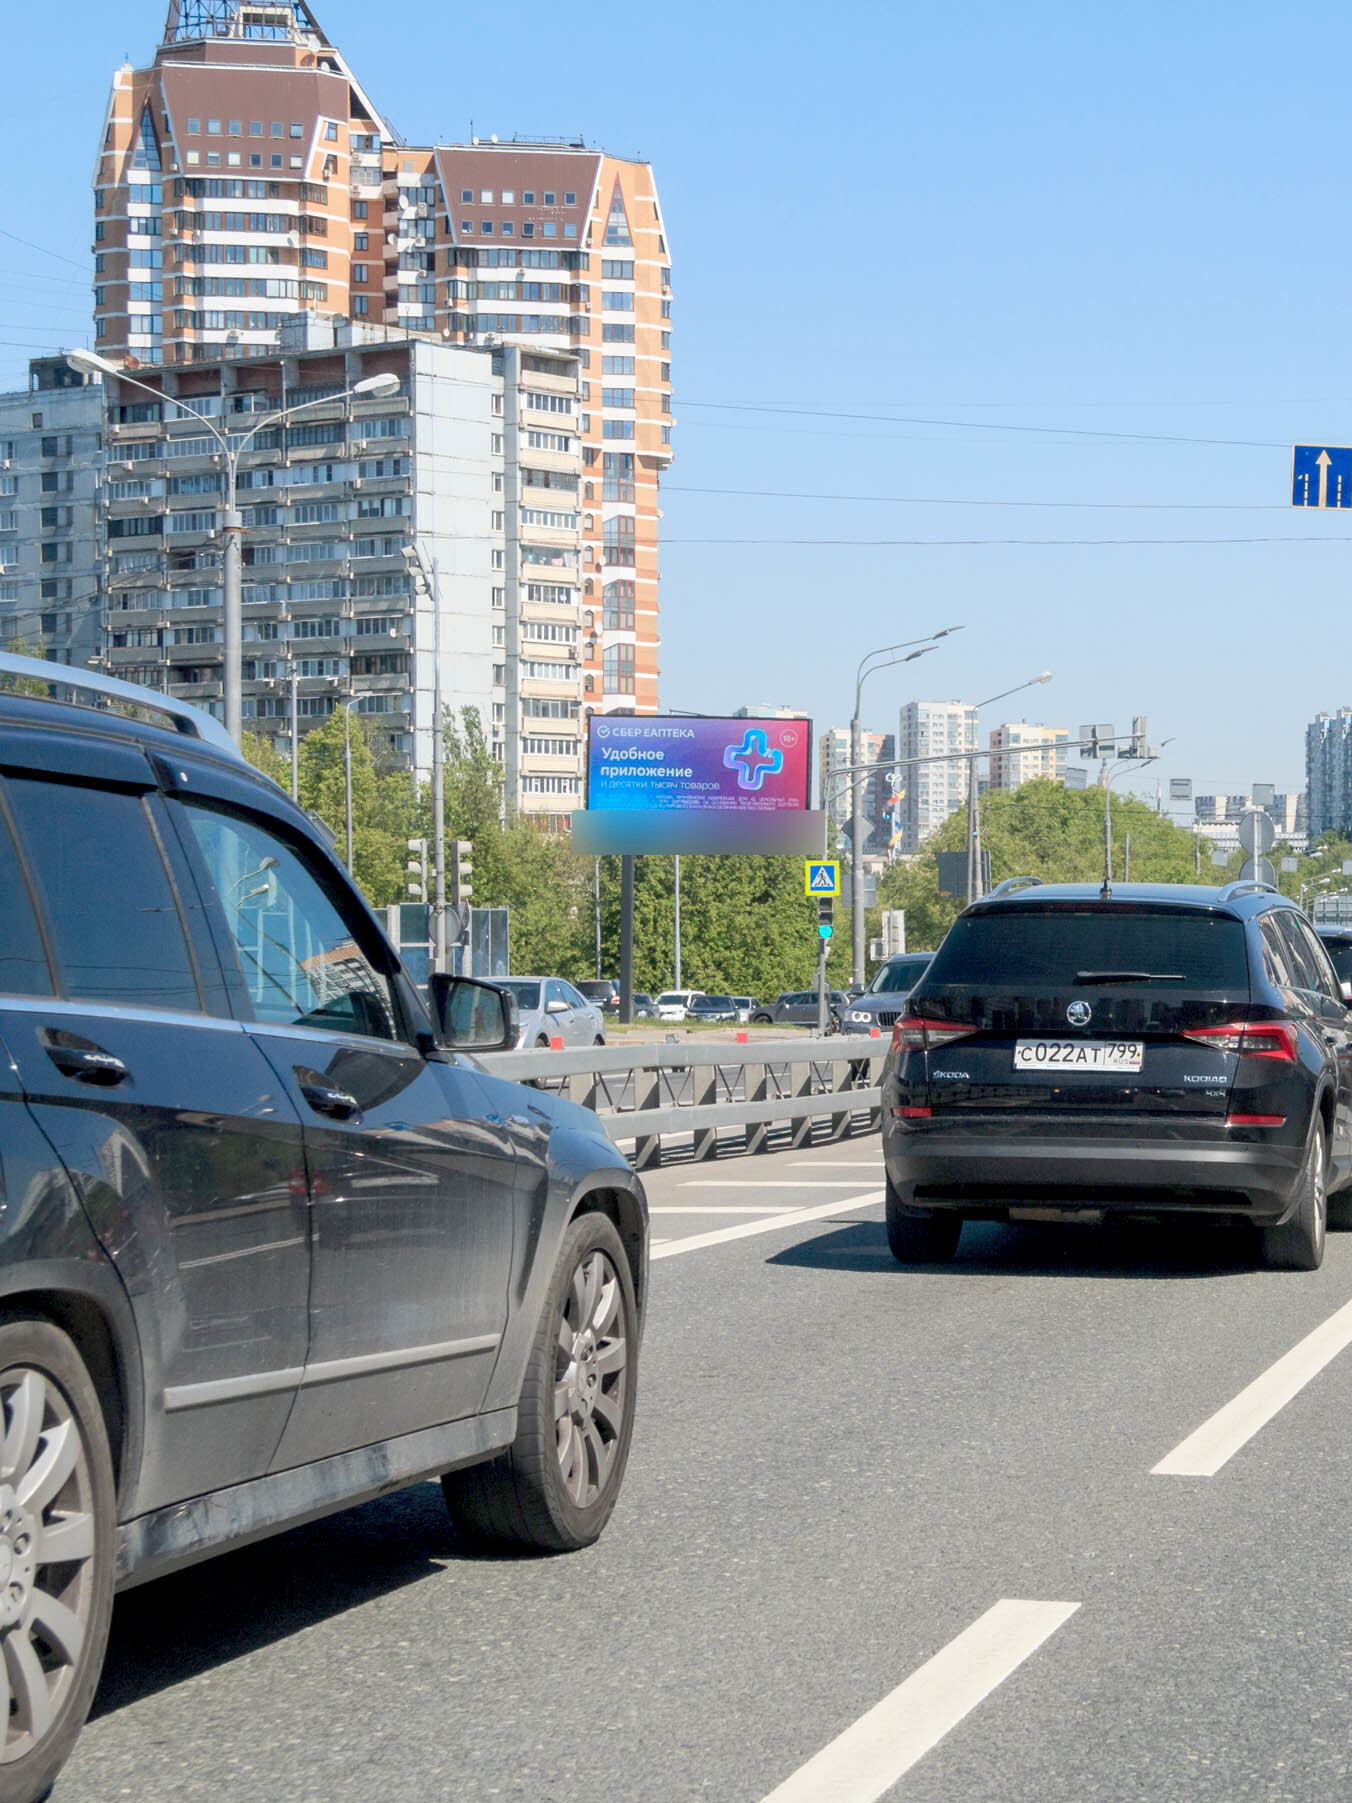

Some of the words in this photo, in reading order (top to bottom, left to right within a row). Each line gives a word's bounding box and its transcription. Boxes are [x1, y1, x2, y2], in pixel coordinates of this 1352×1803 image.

[612, 727, 641, 737] СБЕР
[643, 728, 695, 738] ЕАПТЕКА
[601, 747, 665, 761] Удобное
[601, 766, 693, 778] приложение
[609, 781, 648, 790] десятки
[680, 782, 720, 792] товаров
[1107, 1043, 1137, 1058] 799
[1183, 1075, 1227, 1083] KODIAQ
